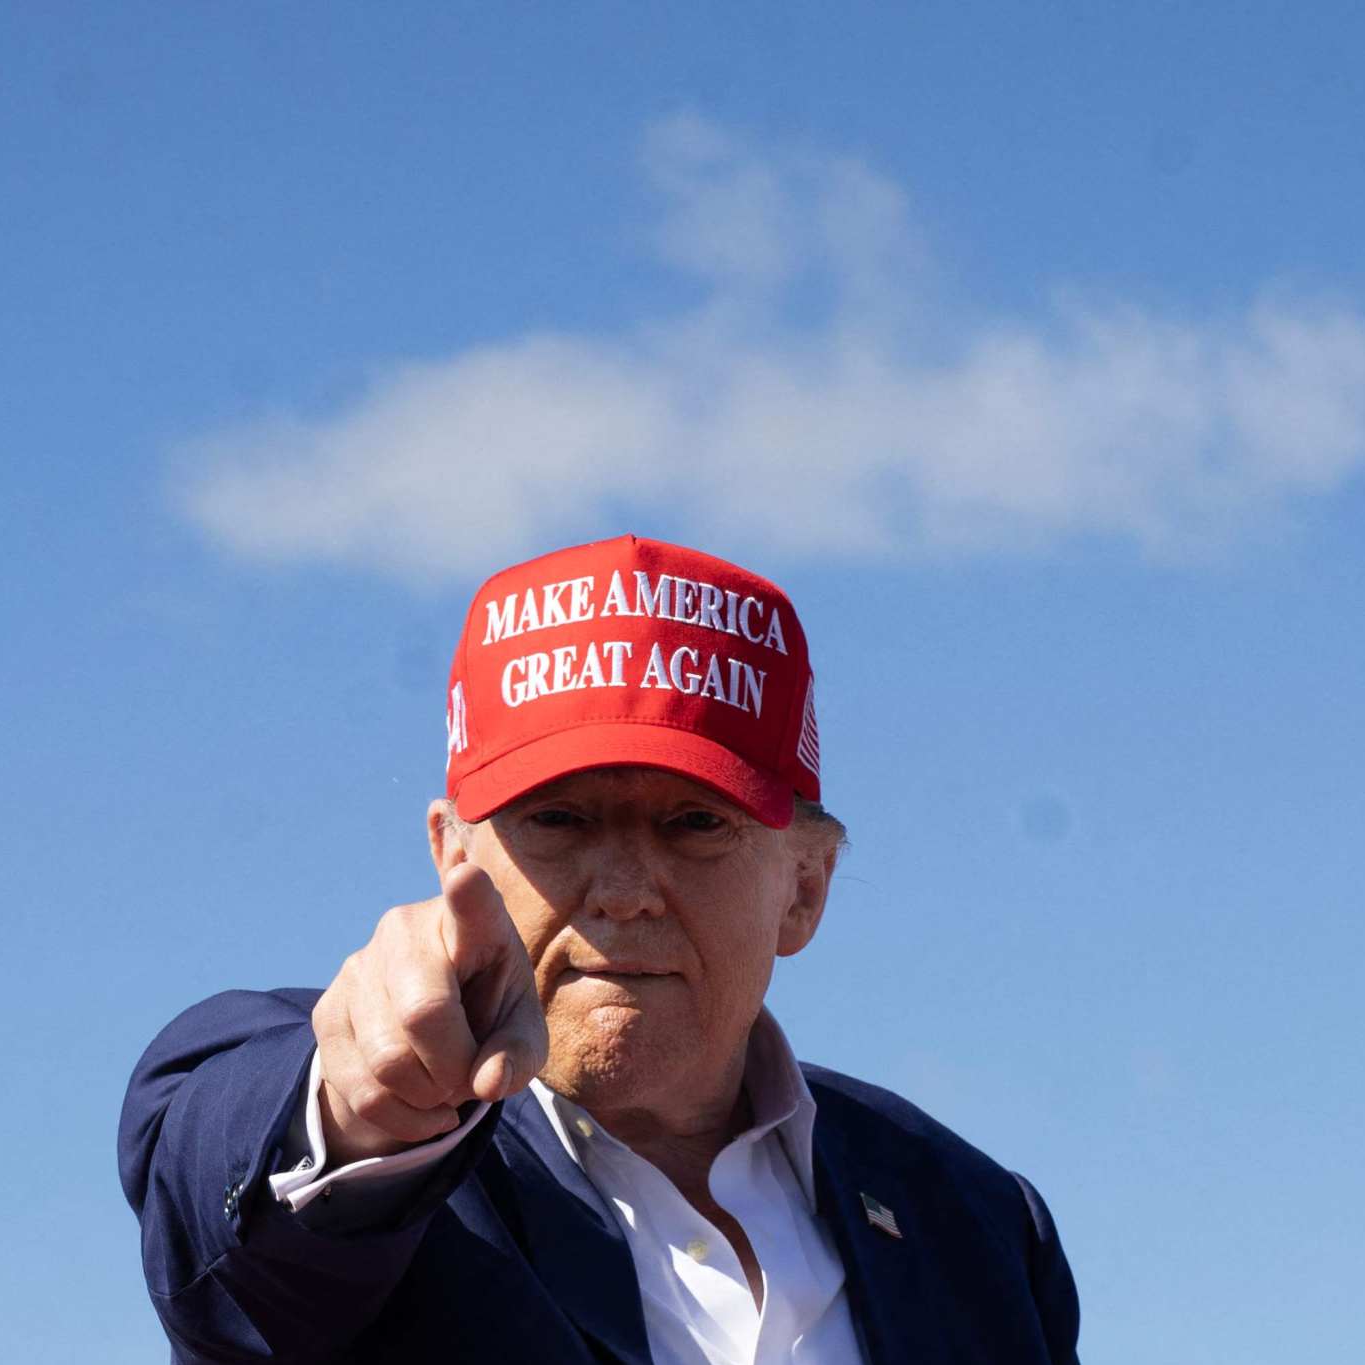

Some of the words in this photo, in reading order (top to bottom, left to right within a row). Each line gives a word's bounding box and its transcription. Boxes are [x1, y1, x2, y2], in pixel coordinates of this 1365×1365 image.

[482, 576, 595, 645] MAKE
[600, 569, 789, 656] AMERICA
[501, 641, 633, 708] GREAT
[641, 641, 767, 719] AGAIN
